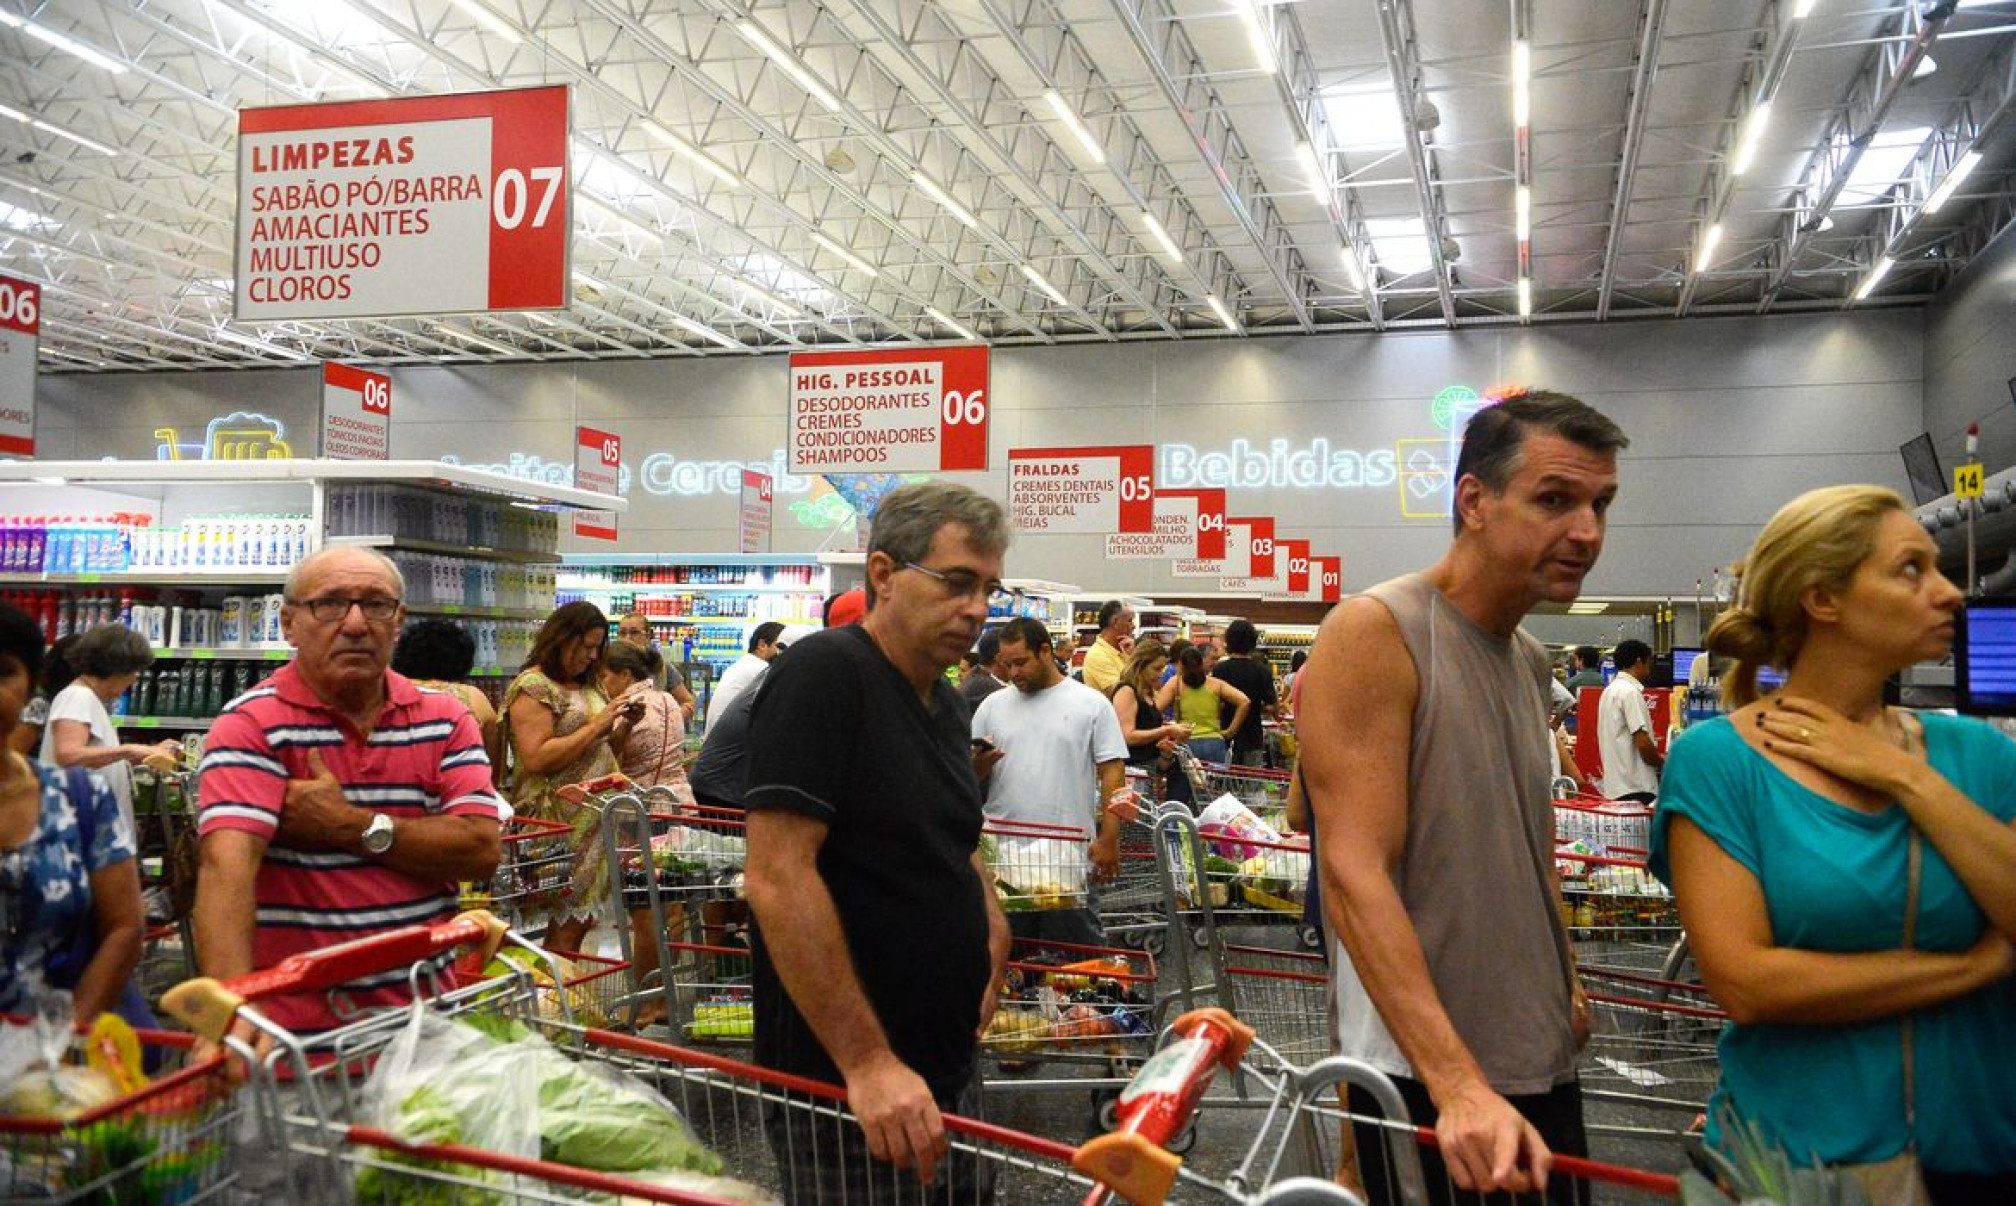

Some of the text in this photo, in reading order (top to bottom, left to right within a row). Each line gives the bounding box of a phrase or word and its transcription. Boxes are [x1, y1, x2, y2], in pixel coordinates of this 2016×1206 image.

[252, 136, 414, 172] LIMPEZAS
[252, 174, 483, 212] SABÃO PÓ/BARRA
[493, 166, 563, 230] 07
[251, 209, 429, 242] AMACIANTES
[250, 243, 381, 272] MULTIUSO
[250, 274, 351, 302] CLOROS
[0, 284, 37, 325] 06
[797, 369, 934, 390] HIG. PESSOAL
[365, 378, 388, 409] 06
[797, 392, 930, 413] DESODORANTES
[943, 389, 985, 425] 06
[797, 413, 862, 430] CREMES
[796, 427, 936, 447] CONDICIONADORES
[602, 439, 618, 462] 05
[796, 447, 887, 464] SHAMPOOS
[641, 449, 812, 494] Cereis
[1014, 464, 1080, 476] FRALDAS
[1160, 437, 1398, 488] Bebidas
[1013, 480, 1114, 492] CREMES DENTAIS
[1121, 476, 1151, 502] 05
[1958, 472, 1978, 492] 14
[1013, 492, 1100, 504] ABSORVENTES
[1013, 505, 1076, 516] HIG. BUCAL
[1012, 517, 1048, 528] MEIAS
[1198, 513, 1224, 531] 04
[1109, 535, 1193, 545] ACHOCOLATADOS
[1252, 539, 1273, 556] 03
[1176, 564, 1221, 573] TORRADAS
[1289, 558, 1308, 573] 02
[1323, 573, 1338, 586] 01
